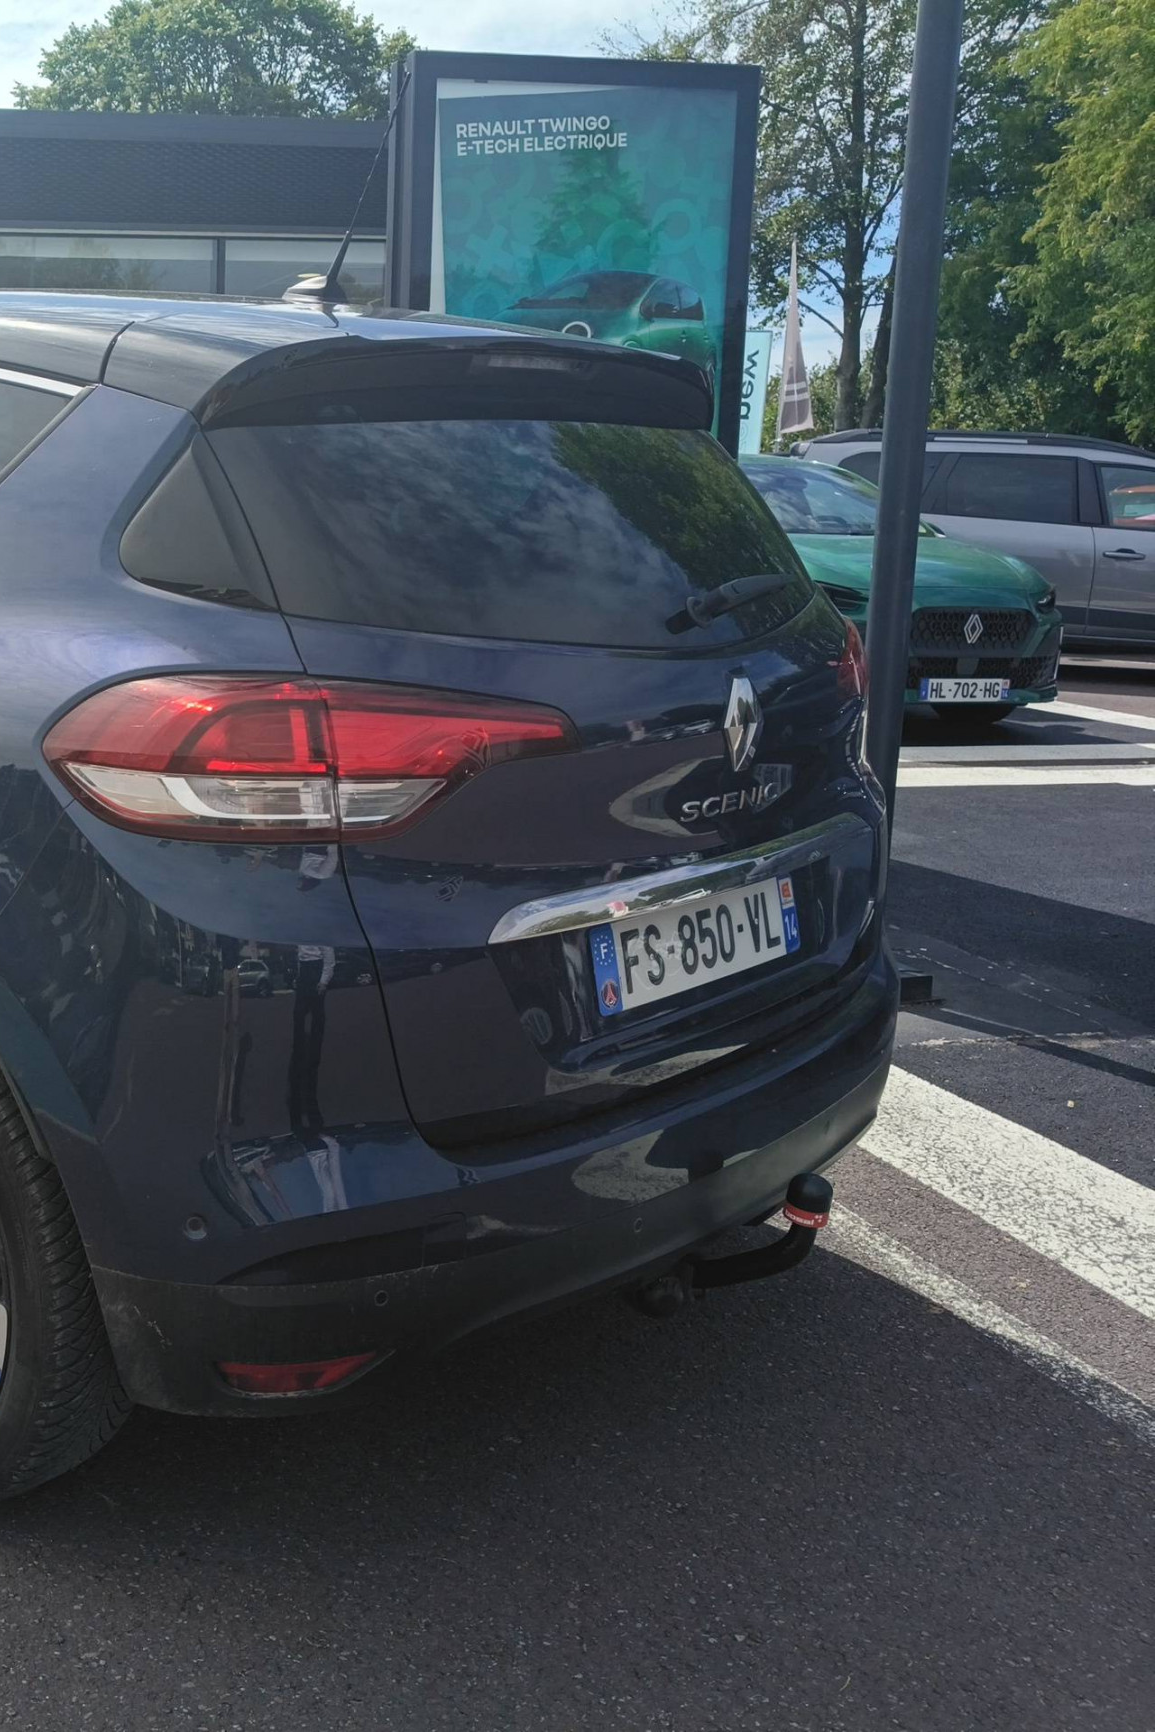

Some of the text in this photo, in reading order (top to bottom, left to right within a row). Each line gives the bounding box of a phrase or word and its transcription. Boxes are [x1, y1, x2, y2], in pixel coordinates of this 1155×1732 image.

[455, 115, 611, 138] RENAULT TWINGO
[456, 132, 628, 156] E-TECH ELECTRIQUE
[930, 682, 1000, 699] HL-702-HG
[680, 782, 778, 823] SCENIC
[784, 912, 798, 941] 14
[600, 942, 608, 959] F
[619, 891, 782, 995] FS-850-VL
